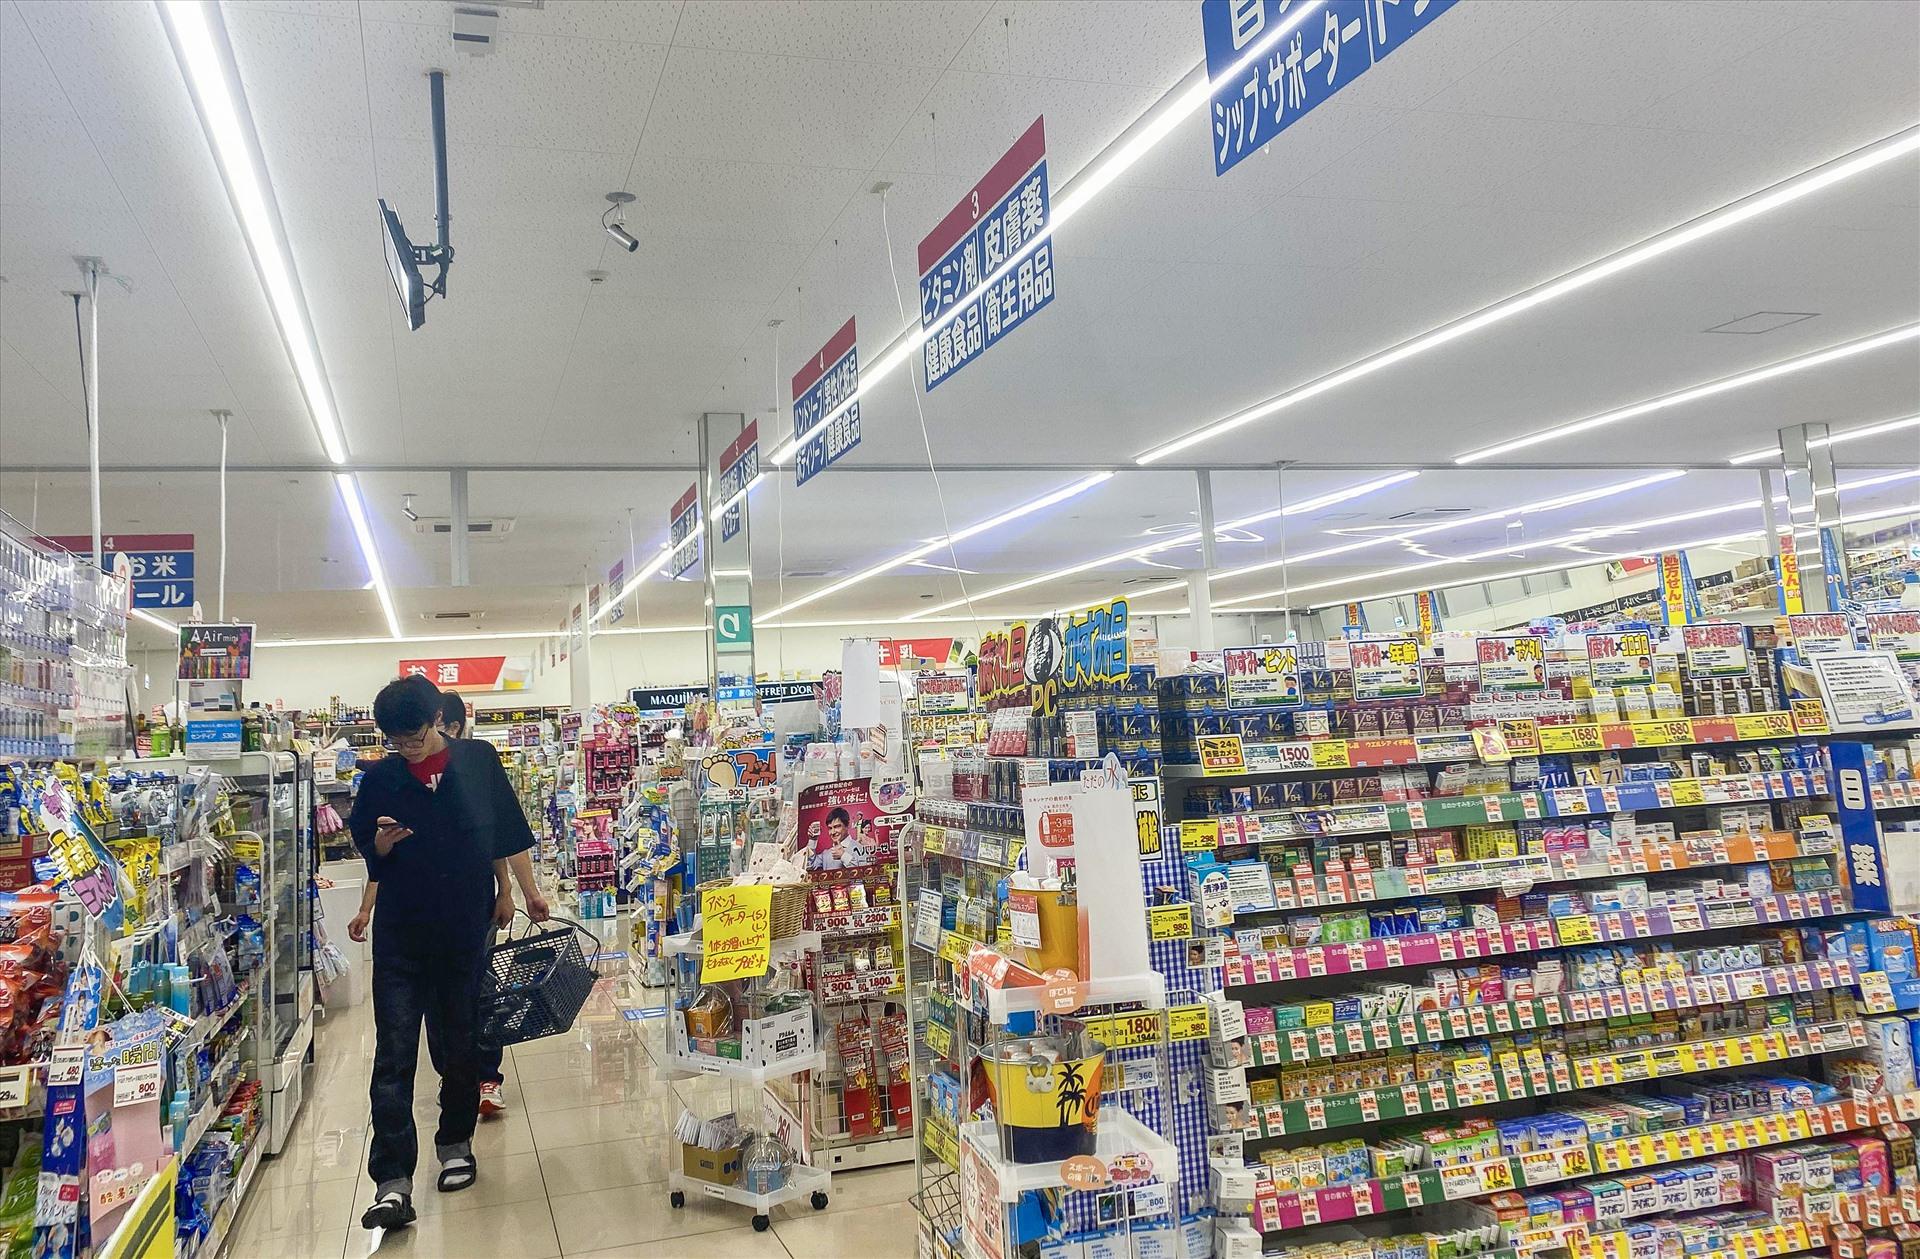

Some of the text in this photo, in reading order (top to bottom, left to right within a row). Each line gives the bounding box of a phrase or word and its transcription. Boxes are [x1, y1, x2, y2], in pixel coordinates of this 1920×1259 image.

[1216, 10, 1361, 164] シップ・サポーター
[971, 190, 980, 220] 3
[984, 175, 1044, 275] 皮膚薬
[921, 237, 979, 326] ビタミン剤
[985, 245, 1052, 341] 衛生用品
[926, 303, 982, 386] 健康食品
[819, 351, 825, 371] 4
[824, 354, 858, 414] 男性化粧品
[794, 390, 823, 438] ハンドソープ
[827, 405, 860, 460] 健康食品
[796, 434, 826, 482] ボディソープ
[104, 537, 115, 550] 4
[130, 555, 177, 577] お米
[1663, 555, 1682, 601] 処方せん
[132, 583, 186, 605] ール
[202, 630, 222, 642] Air
[1064, 600, 1128, 683] かすみ目
[407, 662, 459, 683] お酒
[1031, 679, 1058, 718] PC
[1309, 720, 1327, 731] EX
[1838, 768, 1881, 887] 目薬
[31, 906, 44, 916] 12
[706, 894, 738, 913] アベンヌ
[752, 920, 768, 933] (L)
[1173, 923, 1187, 931] 980
[1447, 920, 1459, 928] PC
[1190, 1022, 1205, 1032] 980
[67, 1065, 79, 1075] 480
[138, 1081, 155, 1093] 800
[1069, 1163, 1096, 1172] スポーツ
[1562, 1151, 1586, 1169] 178
[1483, 1163, 1508, 1182] 178
[1662, 1192, 1688, 1205] アイボン
[1694, 1186, 1718, 1199] アイボン
[1600, 1202, 1626, 1215] アイボン
[1632, 1197, 1657, 1210] アイボン
